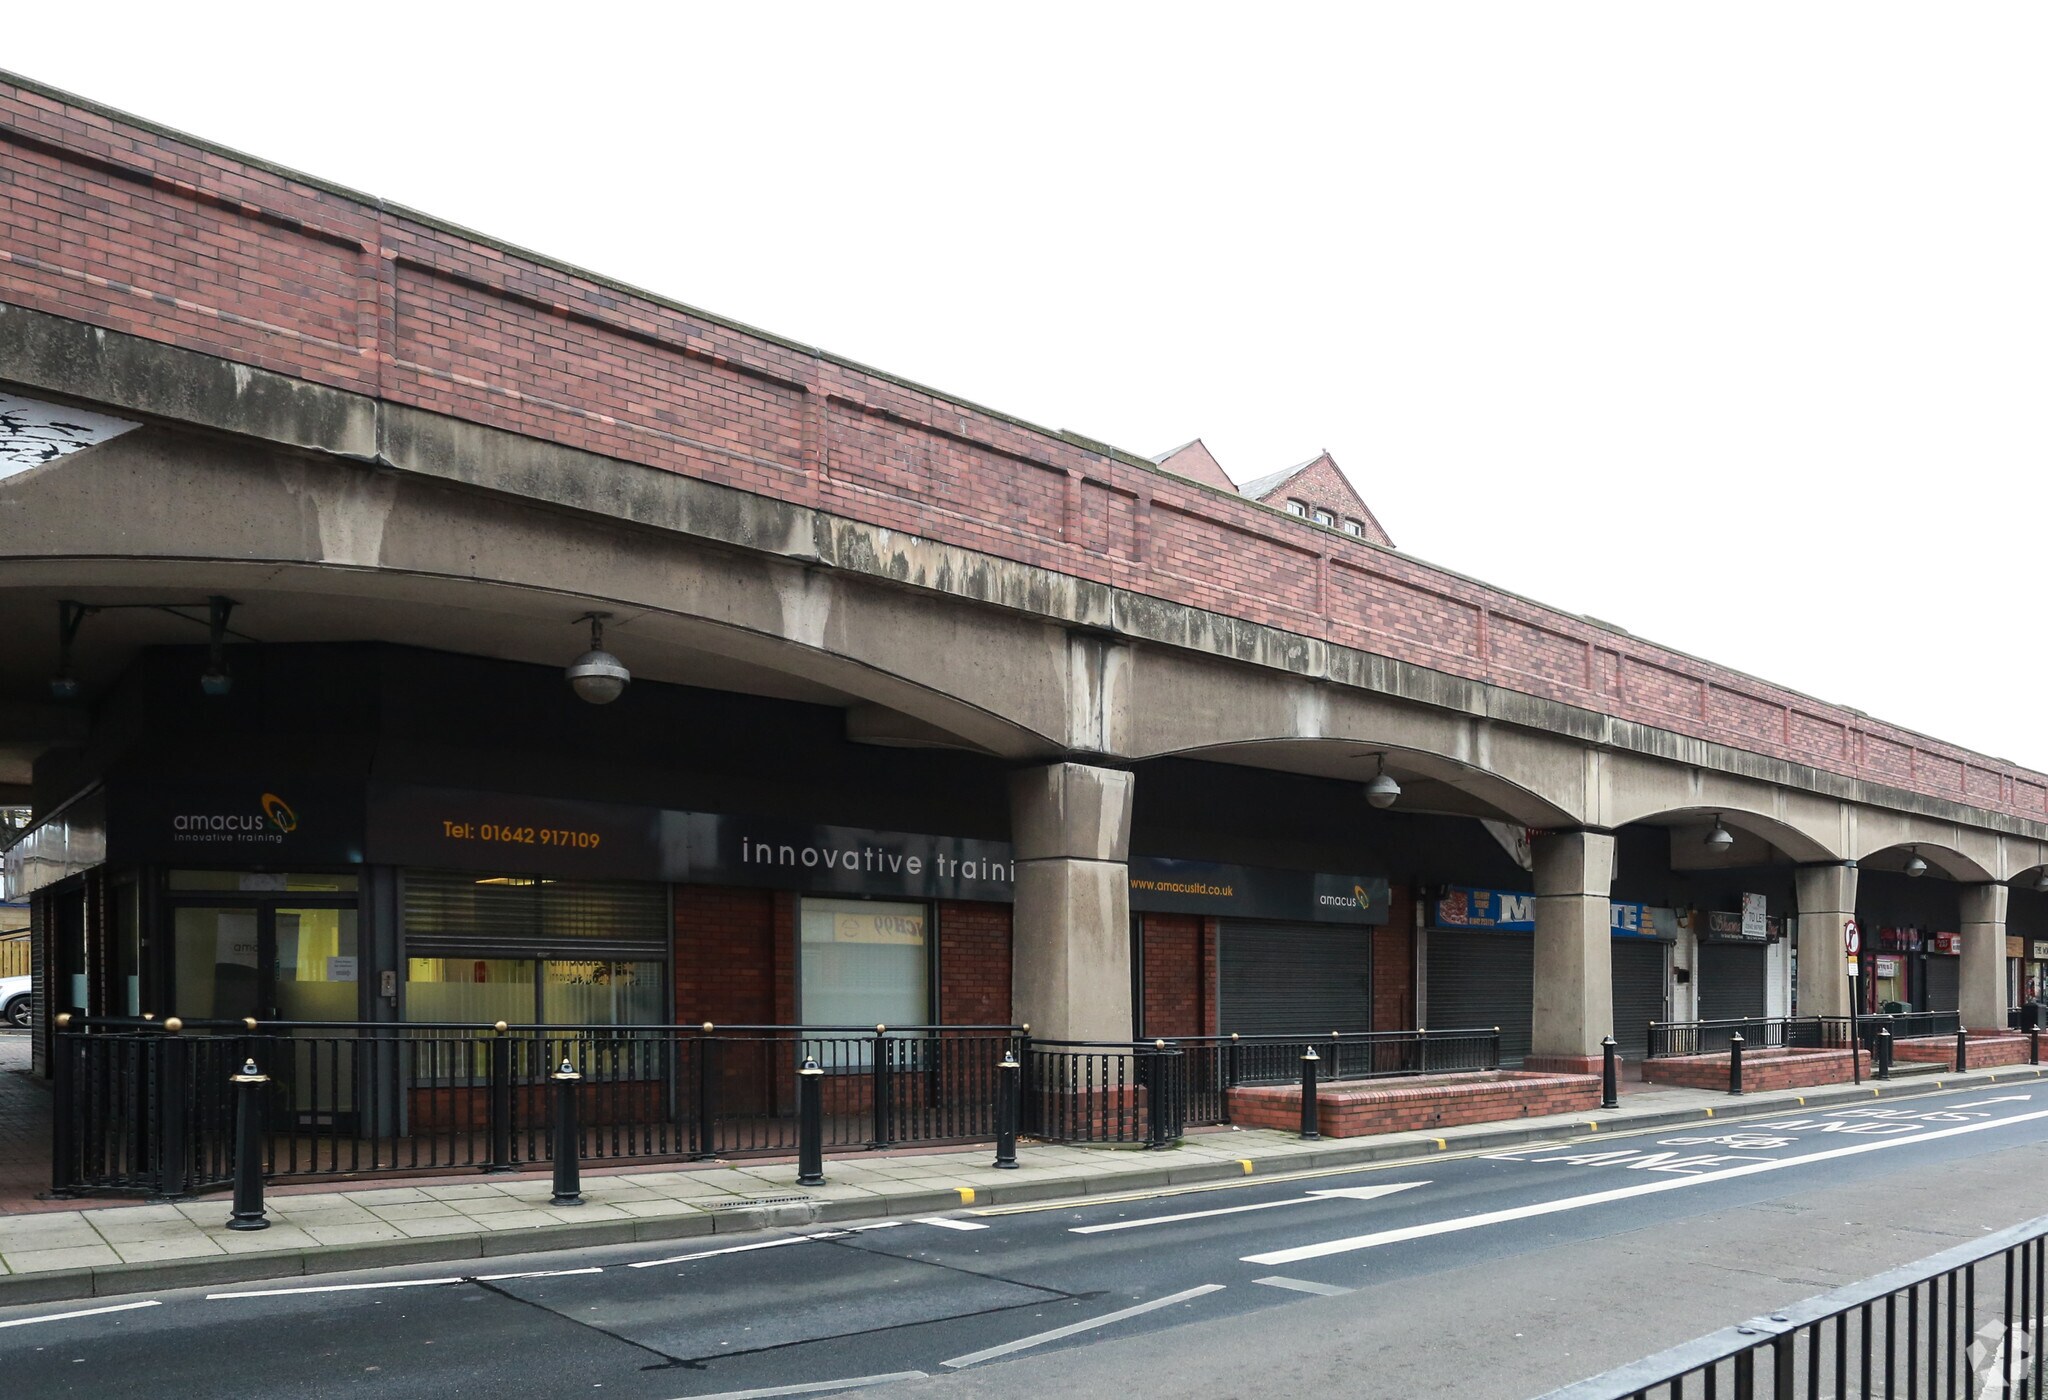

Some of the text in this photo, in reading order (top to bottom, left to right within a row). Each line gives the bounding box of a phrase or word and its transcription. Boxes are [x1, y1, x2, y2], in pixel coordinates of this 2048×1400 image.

[173, 815, 264, 830] amacus
[174, 833, 283, 844] innovative training
[443, 821, 600, 849] Tel: 01642 917109
[742, 836, 922, 875] innovative
[1130, 878, 1233, 897] www.amacusltd.co.uk
[1318, 894, 1357, 907] amacus
[1756, 913, 1765, 923] LET
[1823, 1108, 1991, 1122] BUS
[1738, 1119, 1925, 1134] AND
[1479, 1145, 1778, 1174] LANE
